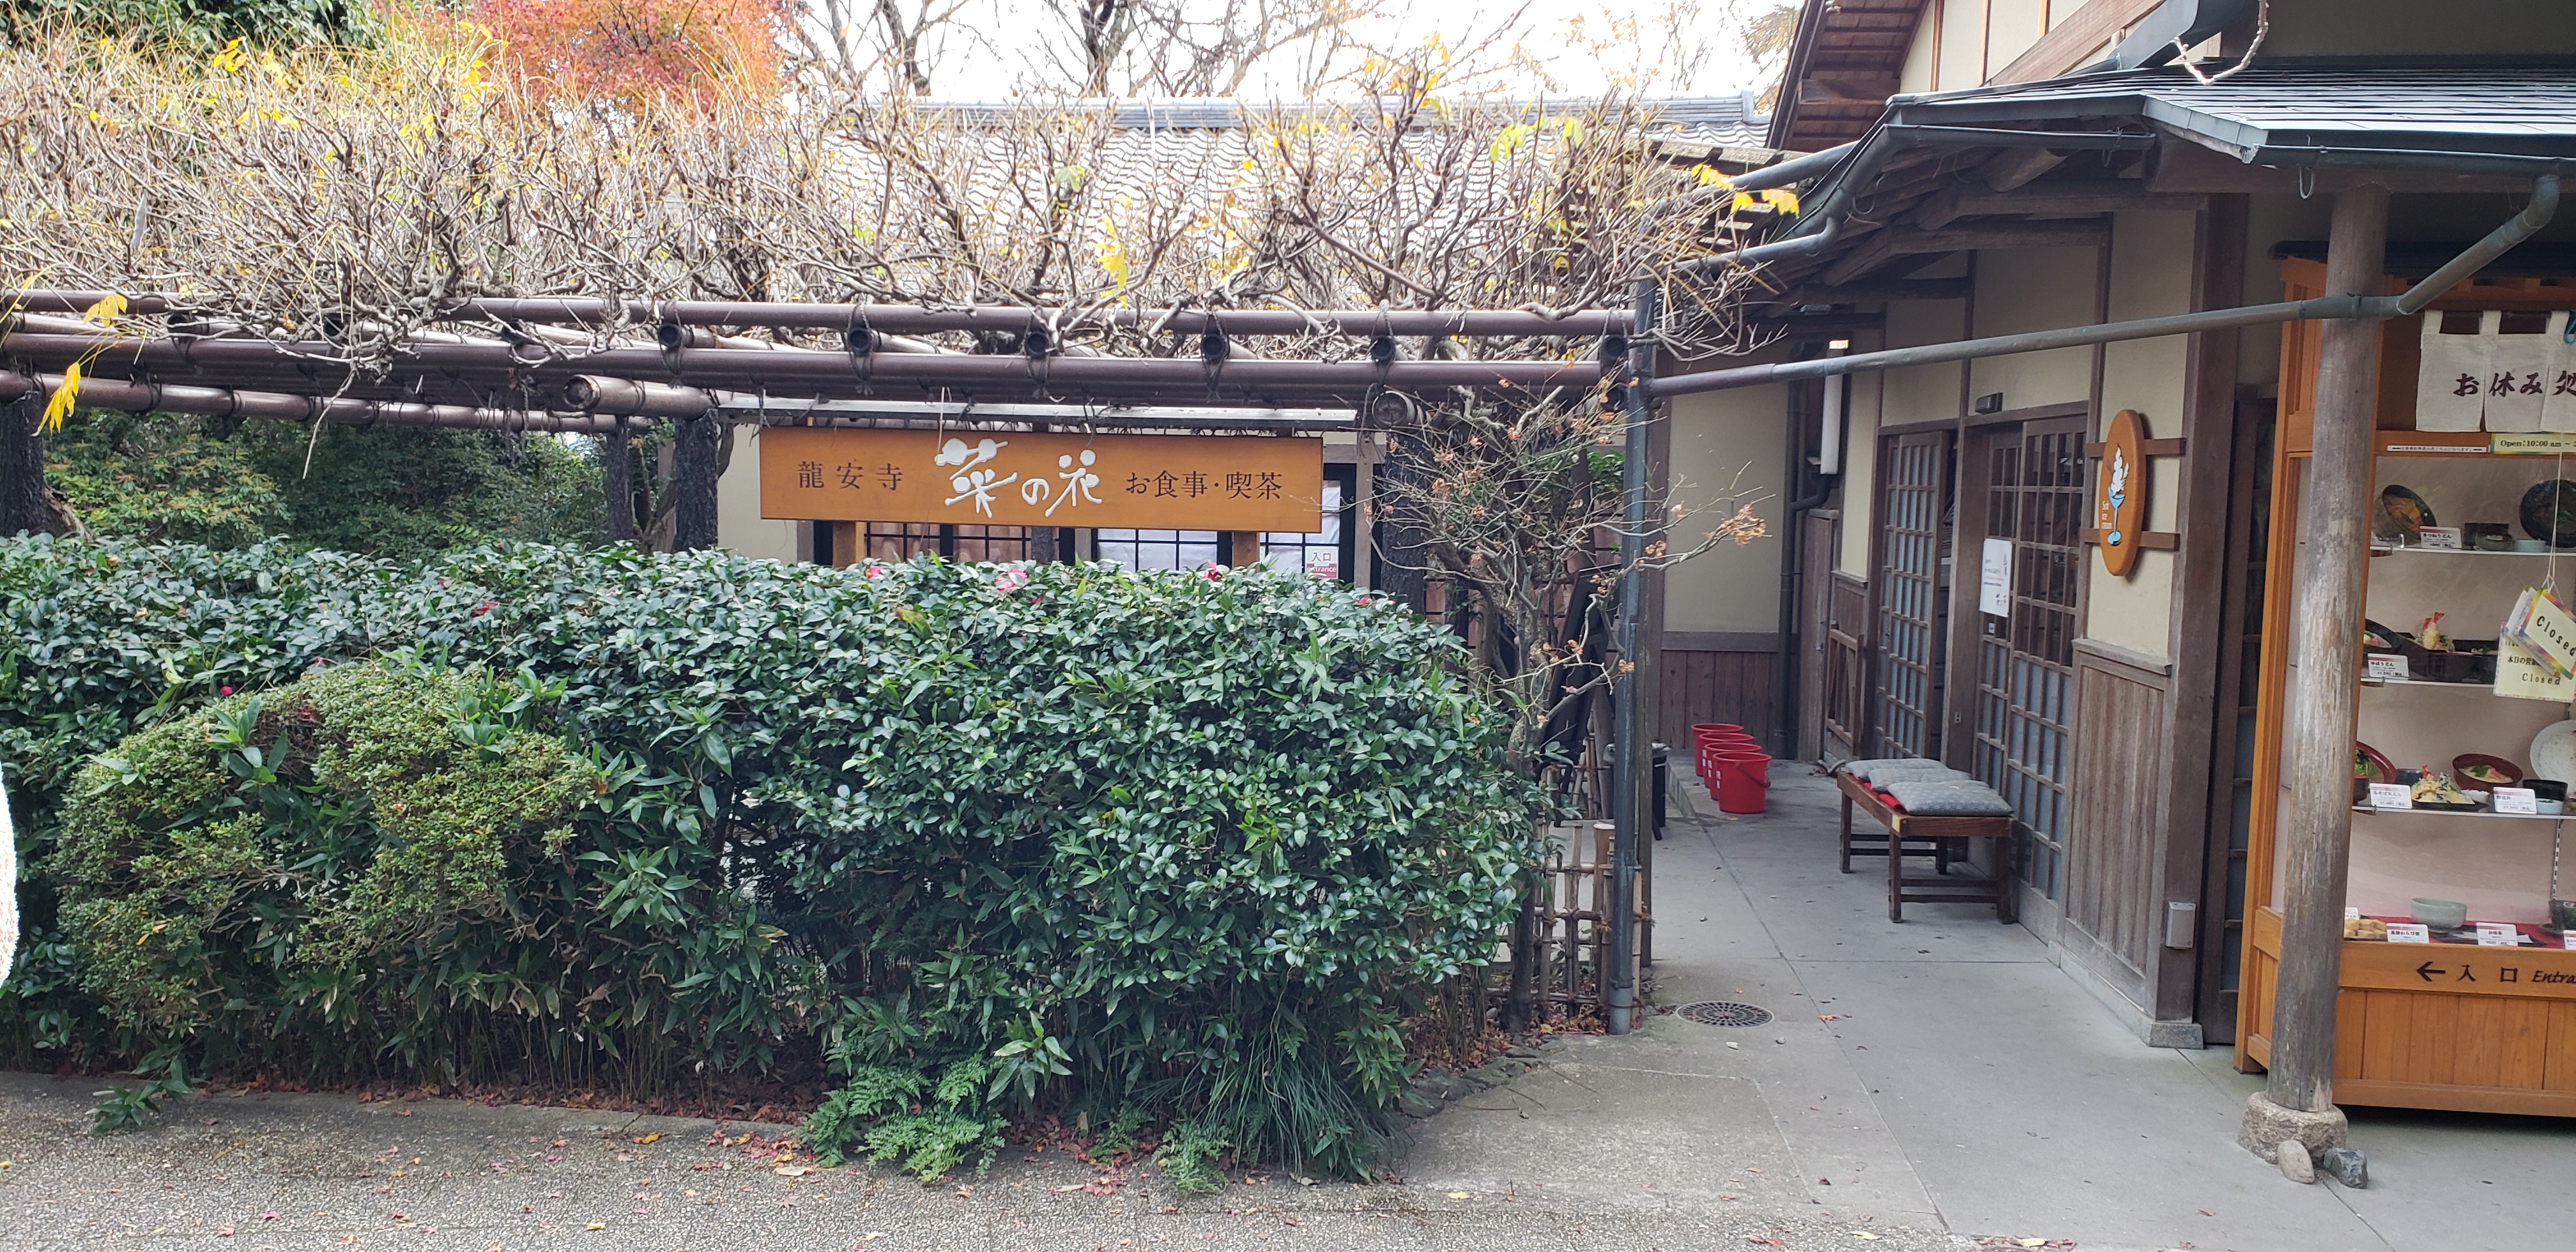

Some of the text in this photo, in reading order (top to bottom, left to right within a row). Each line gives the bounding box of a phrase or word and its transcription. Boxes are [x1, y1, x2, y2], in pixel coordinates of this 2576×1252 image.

[798, 461, 903, 491] 龍安寺
[934, 438, 1103, 519] 菜の花
[1311, 552, 1331, 562] 入口
[2457, 964, 2518, 983] 入口
